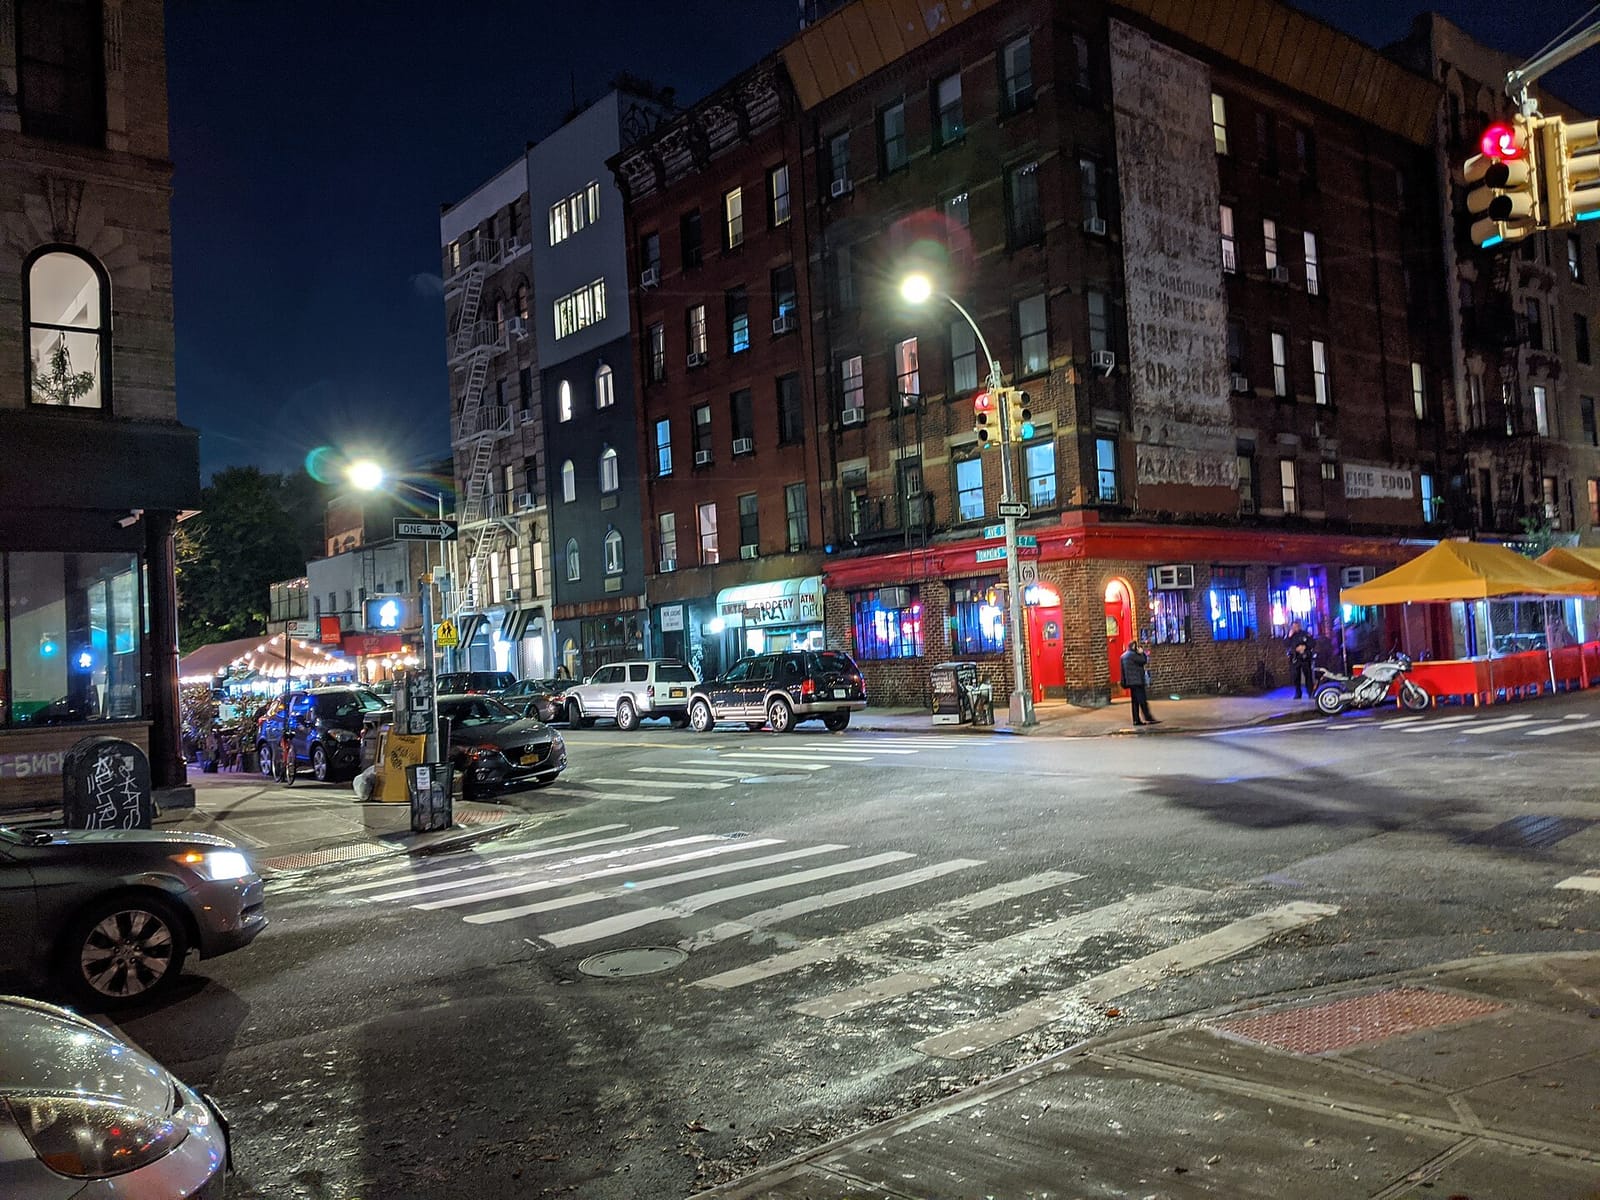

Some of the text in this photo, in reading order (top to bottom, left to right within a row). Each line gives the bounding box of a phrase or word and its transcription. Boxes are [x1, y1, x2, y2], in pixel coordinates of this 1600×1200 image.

[1381, 474, 1411, 490] FOOD
[403, 525, 449, 535] ONE WAY
[987, 527, 997, 537] AVE
[800, 593, 815, 604] ATM
[753, 598, 794, 612] GROCERY
